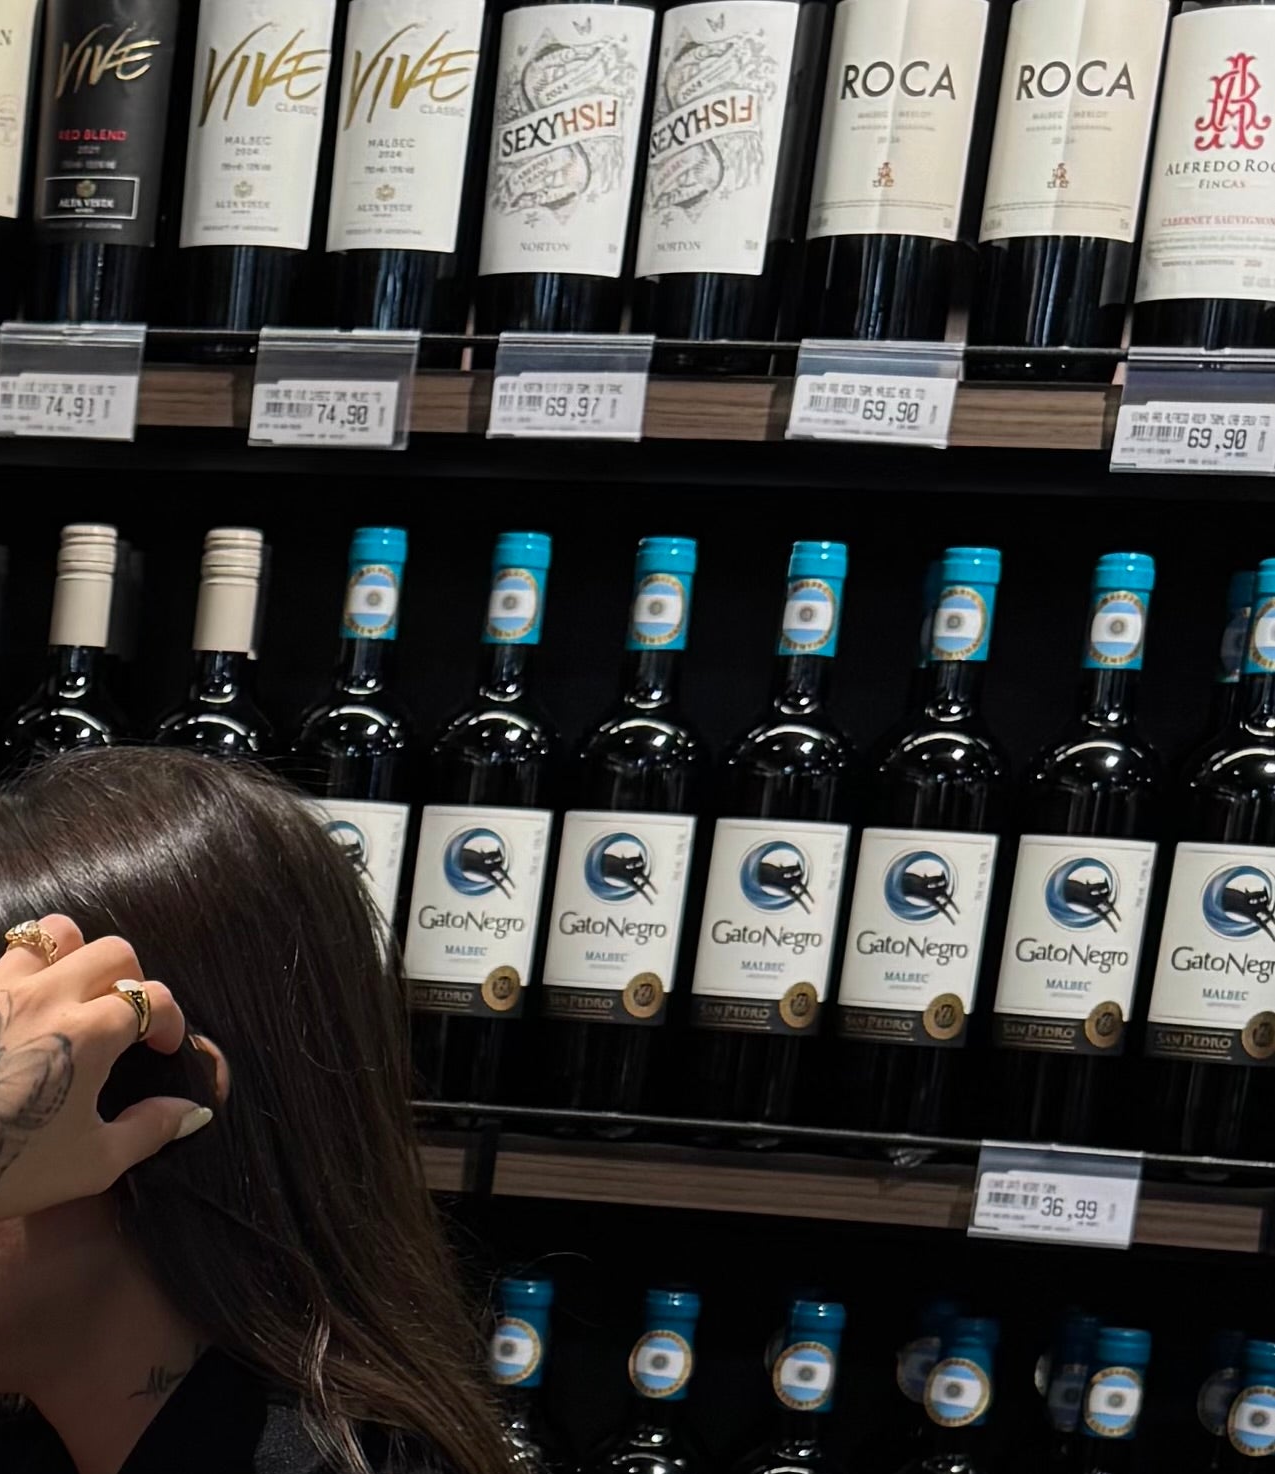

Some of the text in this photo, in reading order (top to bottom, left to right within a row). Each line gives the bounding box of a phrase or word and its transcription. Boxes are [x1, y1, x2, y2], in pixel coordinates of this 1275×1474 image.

[54, 22, 161, 100] VIVE
[199, 22, 331, 128] VIVE
[344, 22, 480, 131] VIVE
[840, 61, 957, 101] ROCA
[1016, 59, 1136, 101] ROCA
[84, 129, 129, 143] BLEND
[1164, 159, 1275, 176] ALFREDO ROC
[1197, 178, 1246, 190] FINCAS
[545, 396, 600, 421] 69,97
[862, 400, 920, 426] 69,90
[1187, 427, 1248, 453] 69,90
[418, 905, 526, 939] GatoNegro
[558, 911, 667, 945] GatoNegro
[711, 920, 823, 955] GatoNegro
[856, 930, 968, 966] GatoNegro
[444, 945, 488, 957] MALBEC
[585, 950, 628, 963] MALBEC
[1015, 937, 1129, 973] GatoNegro
[740, 960, 785, 973] MALBEC
[884, 971, 930, 984] MALBEC
[1170, 947, 1275, 983] GatoNegr
[1045, 978, 1092, 992] MALBEC
[1202, 988, 1249, 1001] MALBEC
[1040, 1196, 1098, 1222] 36,99
